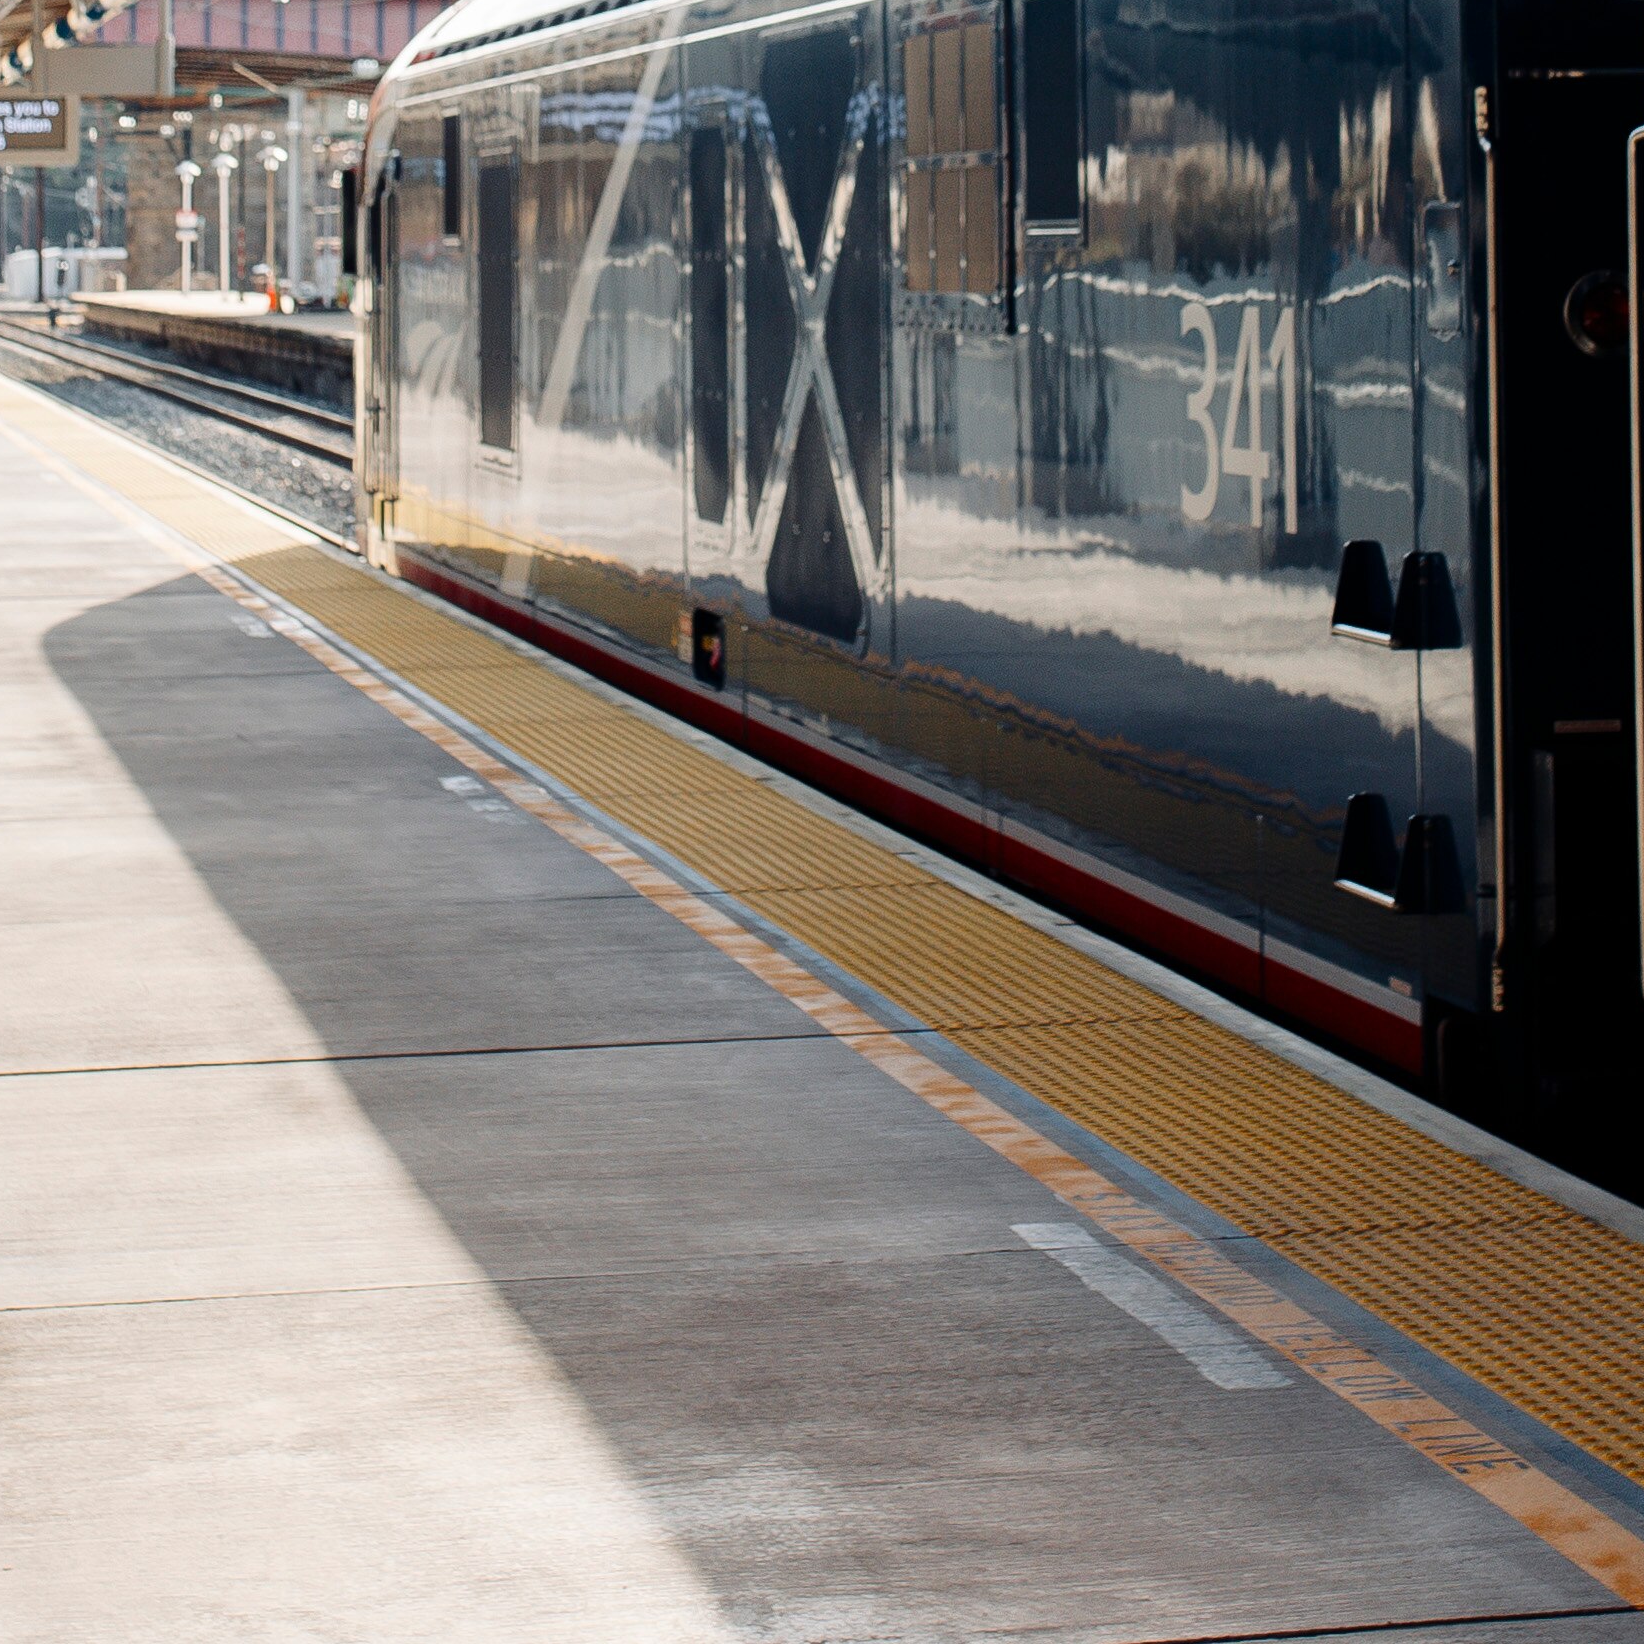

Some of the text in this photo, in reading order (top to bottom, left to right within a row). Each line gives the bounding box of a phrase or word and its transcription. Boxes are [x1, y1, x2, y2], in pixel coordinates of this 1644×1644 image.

[1180, 302, 1298, 535] 341
[1071, 1192, 1531, 1474] STAY BEHIND YELLOW LINE
